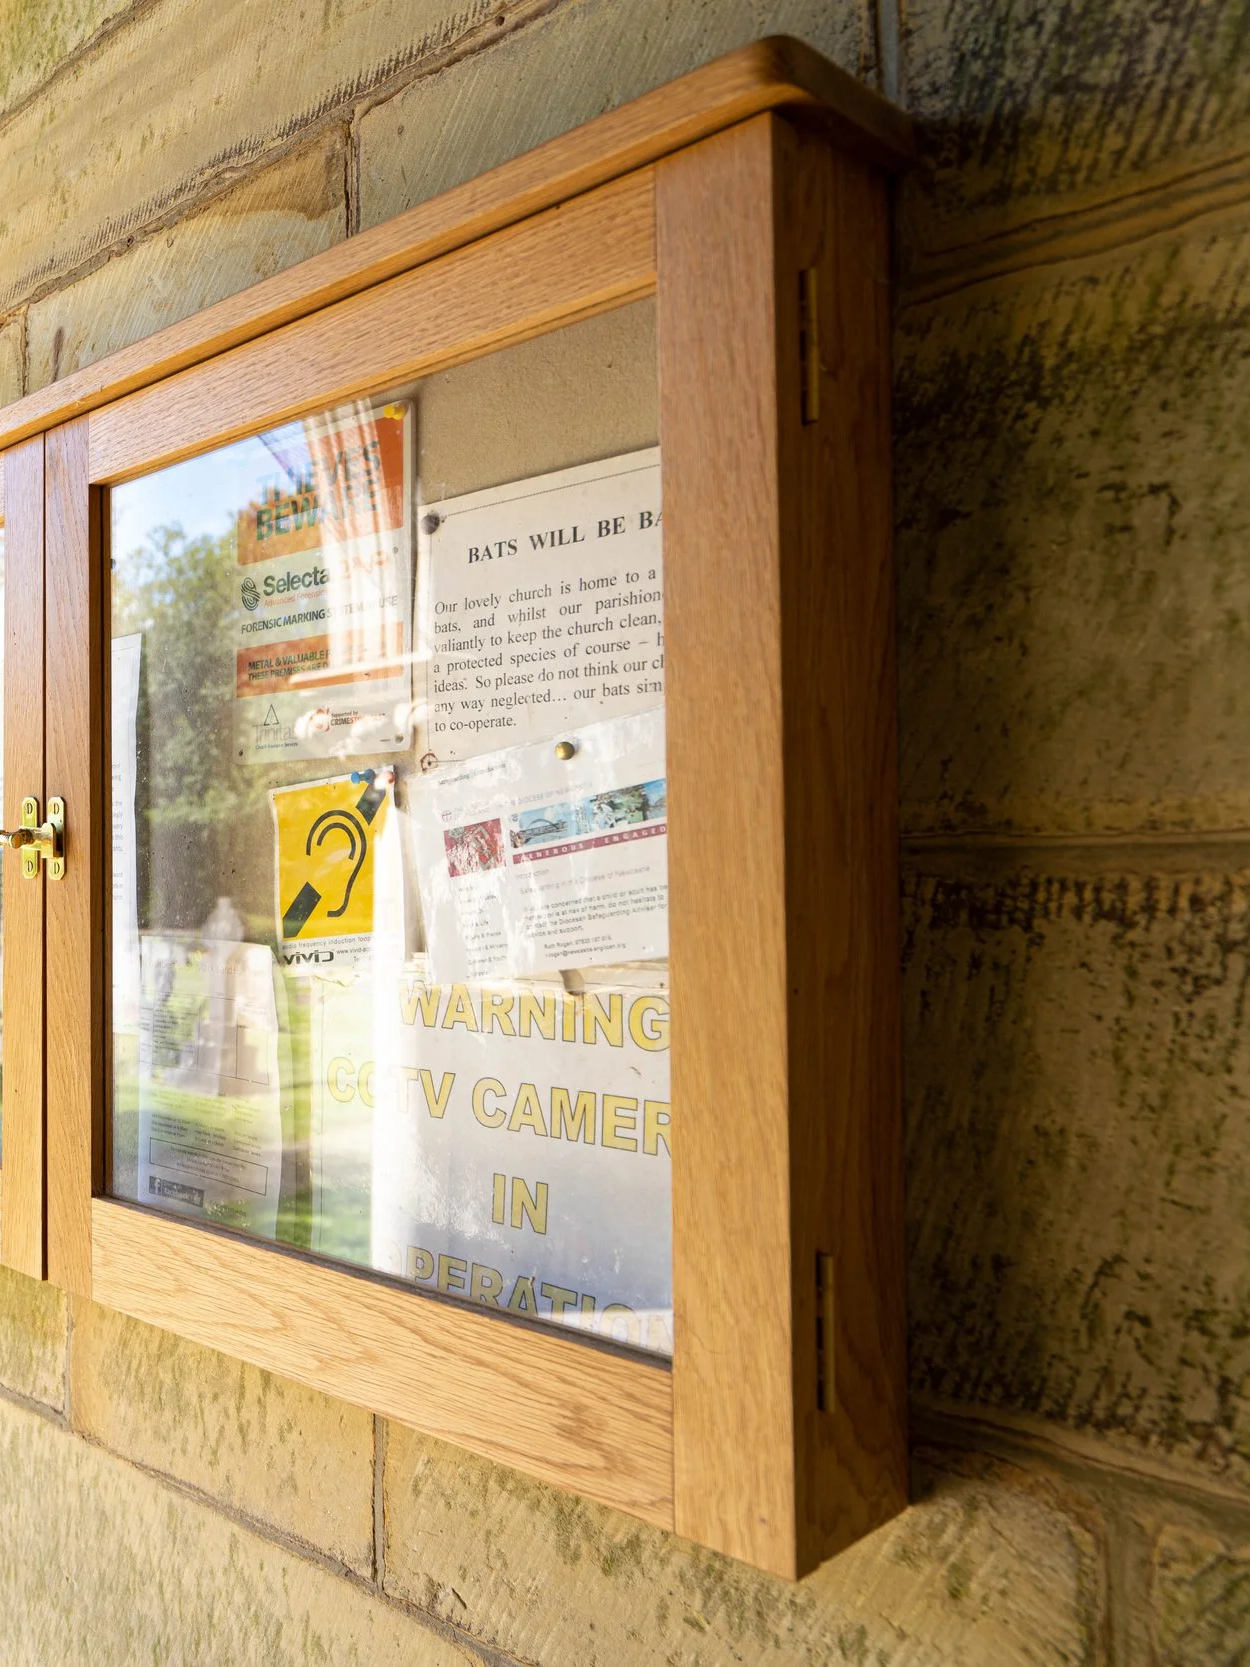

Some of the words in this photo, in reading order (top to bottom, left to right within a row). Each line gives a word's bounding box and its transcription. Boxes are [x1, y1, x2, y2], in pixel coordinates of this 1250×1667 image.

[468, 539, 518, 564] BATS
[529, 526, 585, 550] WILL
[598, 516, 626, 538] BE
[435, 601, 457, 615] Our
[465, 593, 501, 611] lovely
[509, 585, 552, 603] church
[560, 581, 571, 595] is
[579, 576, 617, 592] home
[626, 570, 639, 584] to
[648, 569, 656, 580] a
[242, 617, 282, 634] FORENSIC
[283, 609, 326, 627] MARKING
[434, 620, 461, 634] bats,
[473, 614, 495, 628] and
[508, 607, 546, 625] whilst
[559, 603, 582, 616] our
[435, 635, 485, 654] valiantly
[490, 634, 502, 646] to
[507, 629, 537, 646] keep
[542, 625, 562, 640] the
[567, 616, 613, 636] church
[248, 658, 273, 670] METAL
[282, 651, 325, 666] VALUABLE
[248, 669, 269, 681] THESE
[270, 666, 306, 678] PREMISES
[434, 662, 440, 674] a
[447, 653, 502, 675] protected
[510, 647, 556, 666] species
[563, 643, 579, 657] of
[585, 639, 631, 655] course
[475, 675, 491, 689] So
[495, 671, 534, 690] please
[538, 668, 554, 682] do
[558, 667, 579, 680] not
[584, 660, 618, 677] think
[623, 659, 646, 672] our
[434, 701, 454, 715] any
[461, 697, 485, 712] way
[574, 687, 596, 700] our
[602, 682, 630, 697] bats
[435, 720, 446, 732] to
[450, 716, 517, 733] co-operate.
[521, 843, 584, 861] ENEROUS
[605, 826, 666, 844] ENGAGED
[328, 936, 356, 945] induction
[357, 935, 372, 944] loop
[400, 980, 671, 1052] WARNING
[327, 1056, 455, 1120] CCTV
[492, 1173, 549, 1235] IN
[393, 1240, 673, 1352] PERATIO
